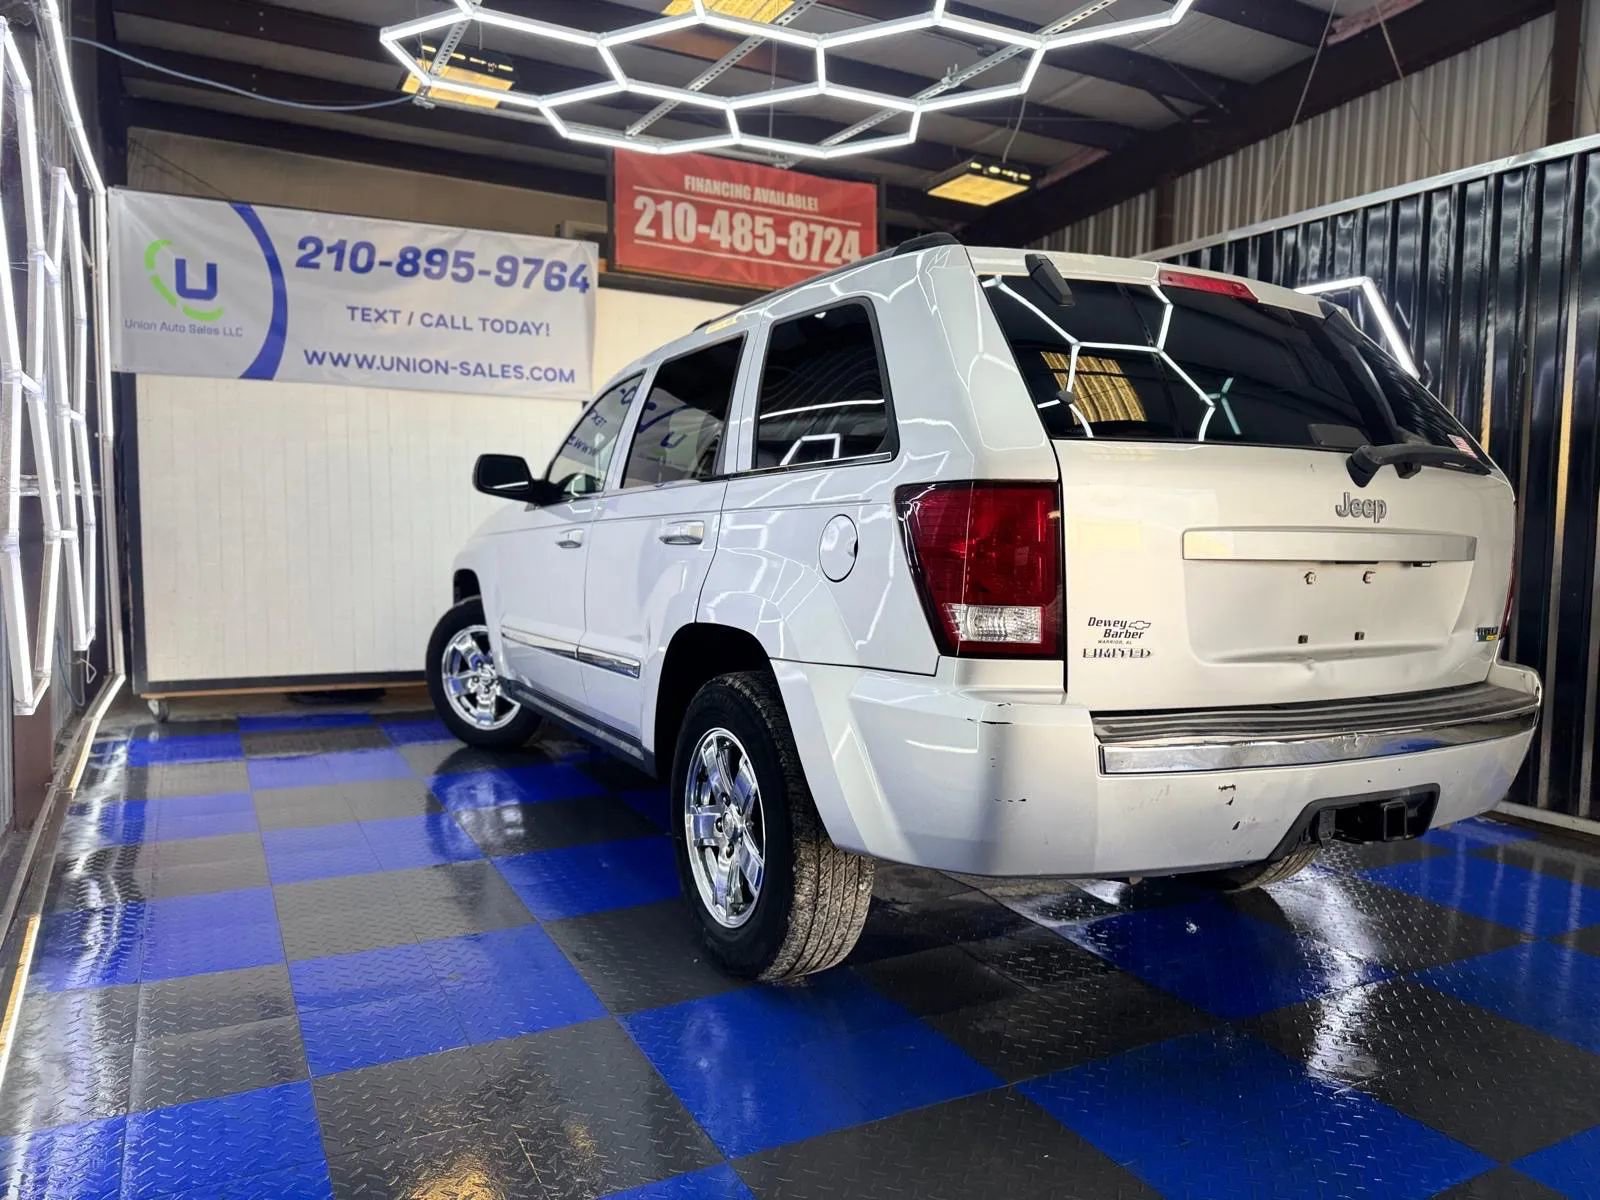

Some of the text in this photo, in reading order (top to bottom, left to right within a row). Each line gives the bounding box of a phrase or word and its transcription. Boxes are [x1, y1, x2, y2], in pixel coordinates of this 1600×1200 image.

[684, 175, 819, 212] FINANCING AVAILABLE!
[634, 195, 861, 265] 210-485-8724
[174, 257, 218, 301] U
[295, 235, 591, 294] 210-895-9764
[124, 318, 243, 338] Union Auto Sales LLC
[347, 305, 551, 337] TEXT / CALL TODAY!
[303, 349, 576, 384] WWW.UNION-SALES.COM
[1335, 491, 1388, 524] Jeep
[1087, 616, 1128, 630] Dewey
[1103, 628, 1145, 639] Barber
[1082, 648, 1152, 658] LIMITED
